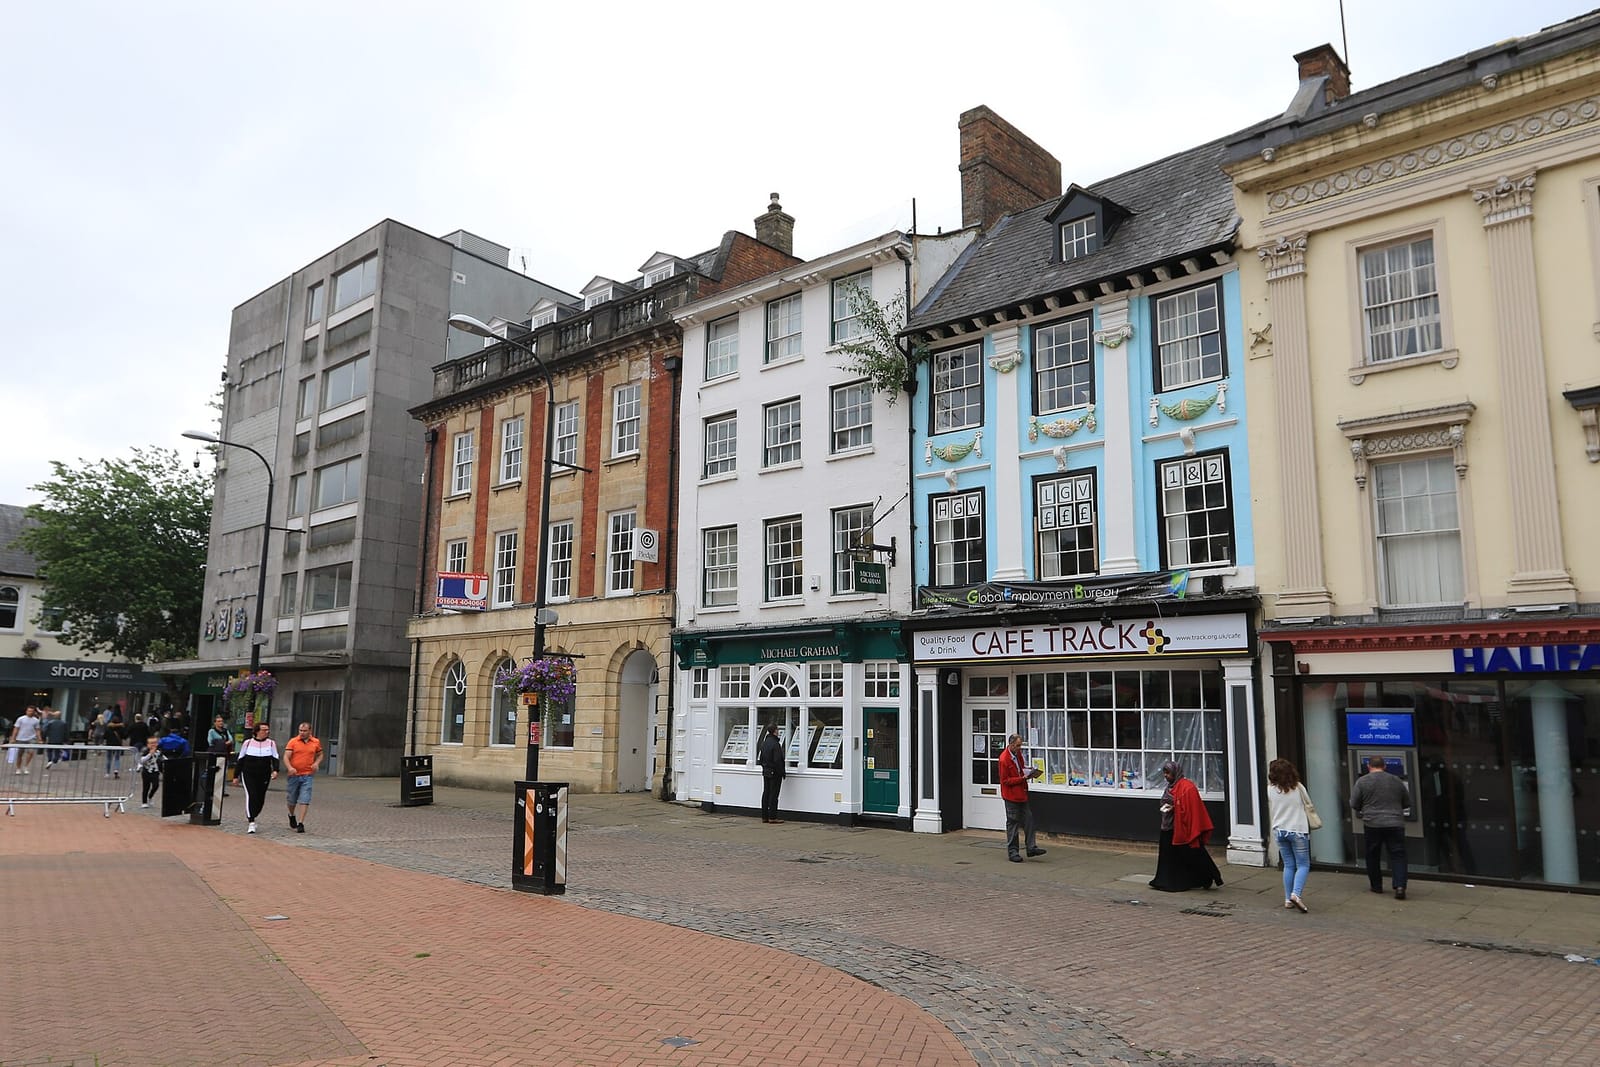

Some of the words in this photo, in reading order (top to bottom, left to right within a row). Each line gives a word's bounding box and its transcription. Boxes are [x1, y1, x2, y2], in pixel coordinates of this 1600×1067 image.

[1044, 482, 1088, 501] LGV
[939, 501, 979, 517] HGV
[920, 636, 946, 646] Quality
[947, 635, 966, 644] Food
[971, 629, 1034, 656] CAFE
[1043, 623, 1137, 652] TRACK
[1175, 632, 1241, 642] www.track.org.uk/cafe
[761, 647, 798, 659] MICHAEL
[799, 646, 839, 657] GRAHAM
[929, 646, 936, 655] &
[937, 646, 957, 655] Drink
[51, 663, 99, 681] sharps
